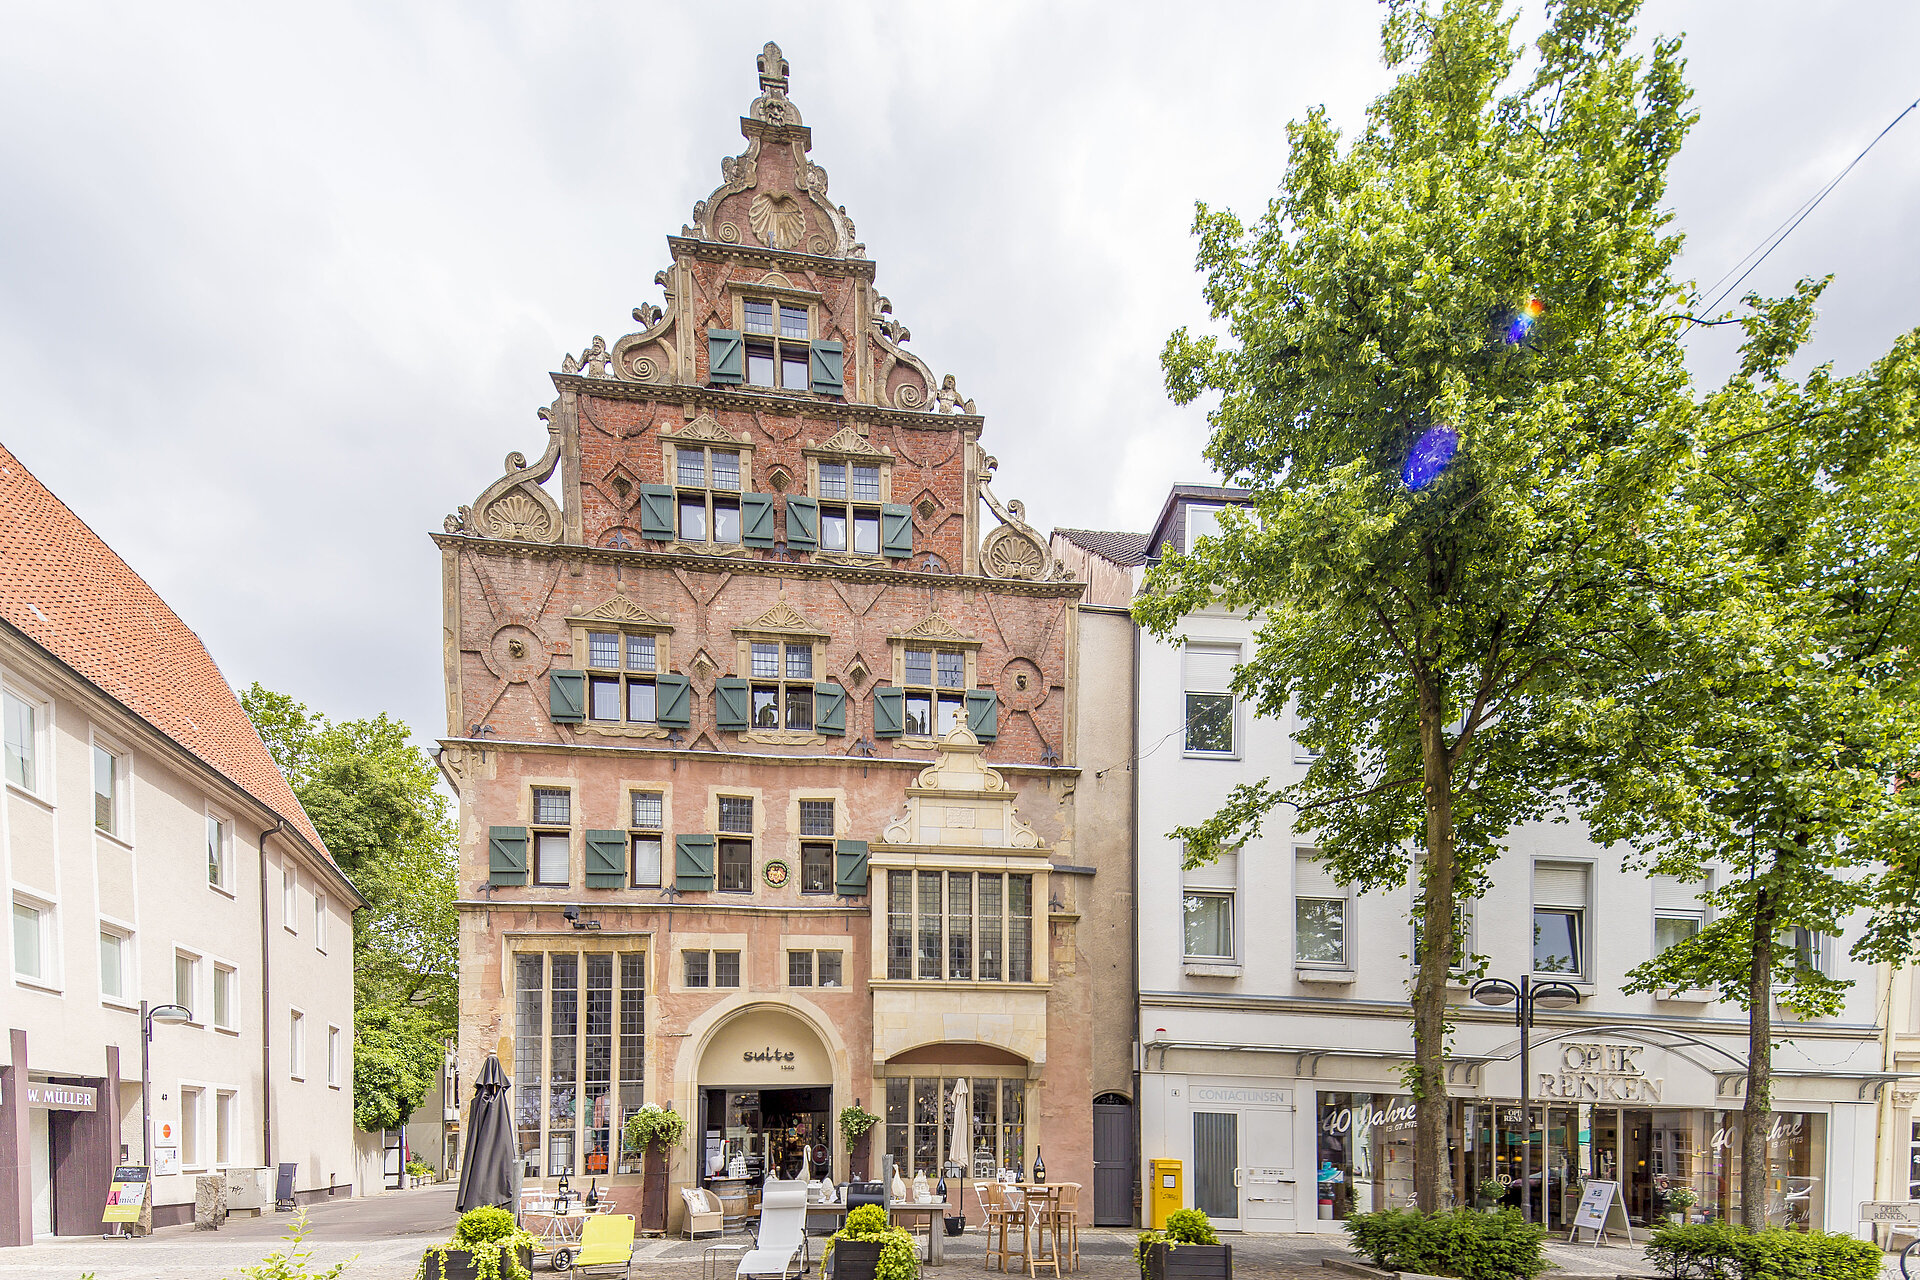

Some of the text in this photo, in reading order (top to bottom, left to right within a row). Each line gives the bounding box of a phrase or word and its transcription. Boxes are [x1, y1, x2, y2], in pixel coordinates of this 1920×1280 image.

[743, 1046, 795, 1062] suite
[43, 1087, 92, 1106] MÜLLER
[1198, 1089, 1284, 1102] CONTACTLINSEN
[1538, 1072, 1663, 1102] RENKEN
[1322, 1097, 1417, 1138] 40 Jahre
[1710, 1115, 1803, 1151] 40 hre
[1874, 1212, 1908, 1220] RENKEN
